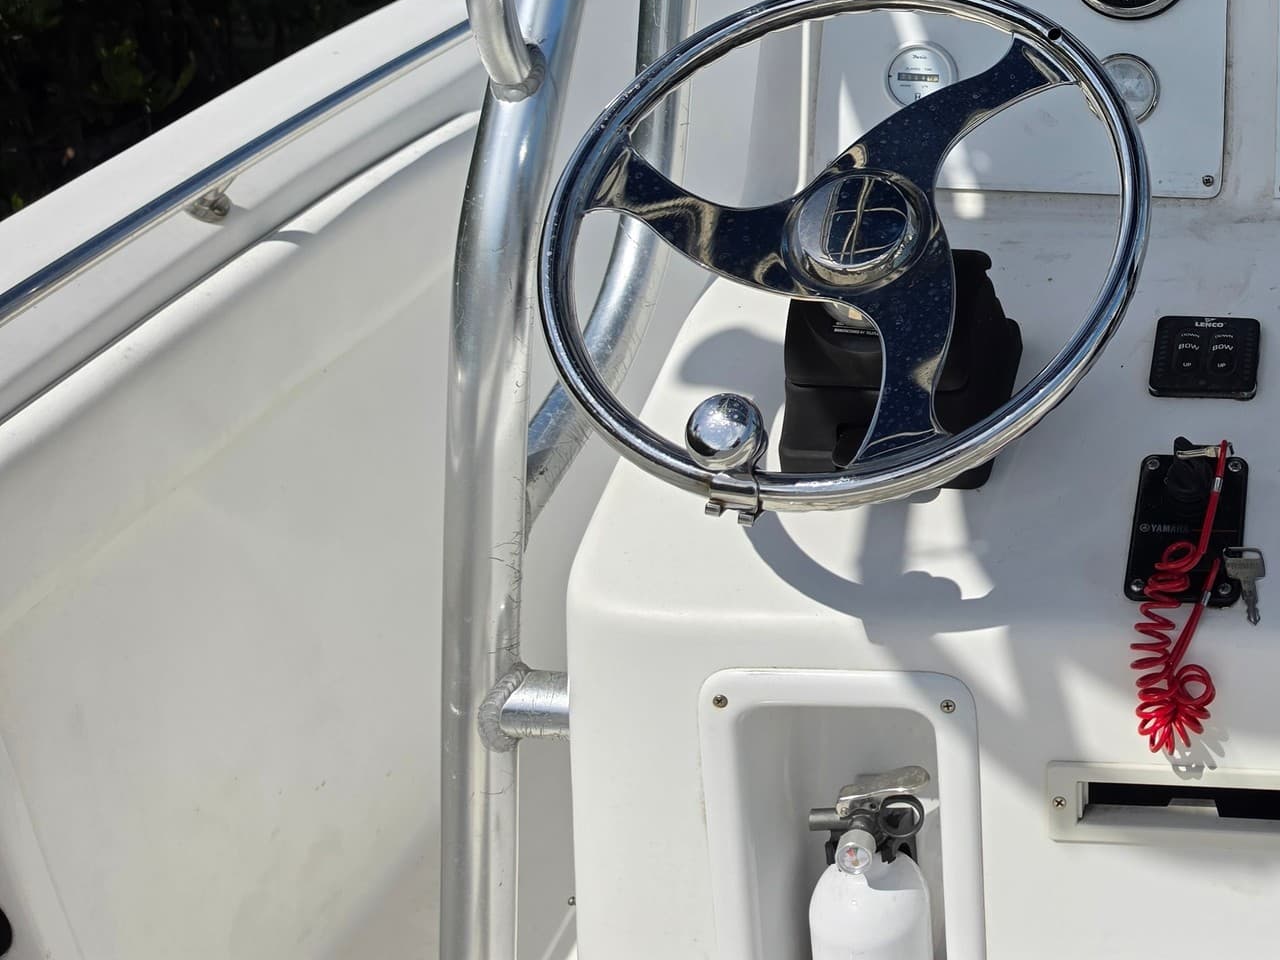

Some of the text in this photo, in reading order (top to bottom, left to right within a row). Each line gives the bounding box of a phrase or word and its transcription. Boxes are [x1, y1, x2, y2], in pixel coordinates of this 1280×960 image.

[1194, 321, 1224, 329] LENCO
[1178, 342, 1200, 351] BOW
[1212, 343, 1234, 352] BOW
